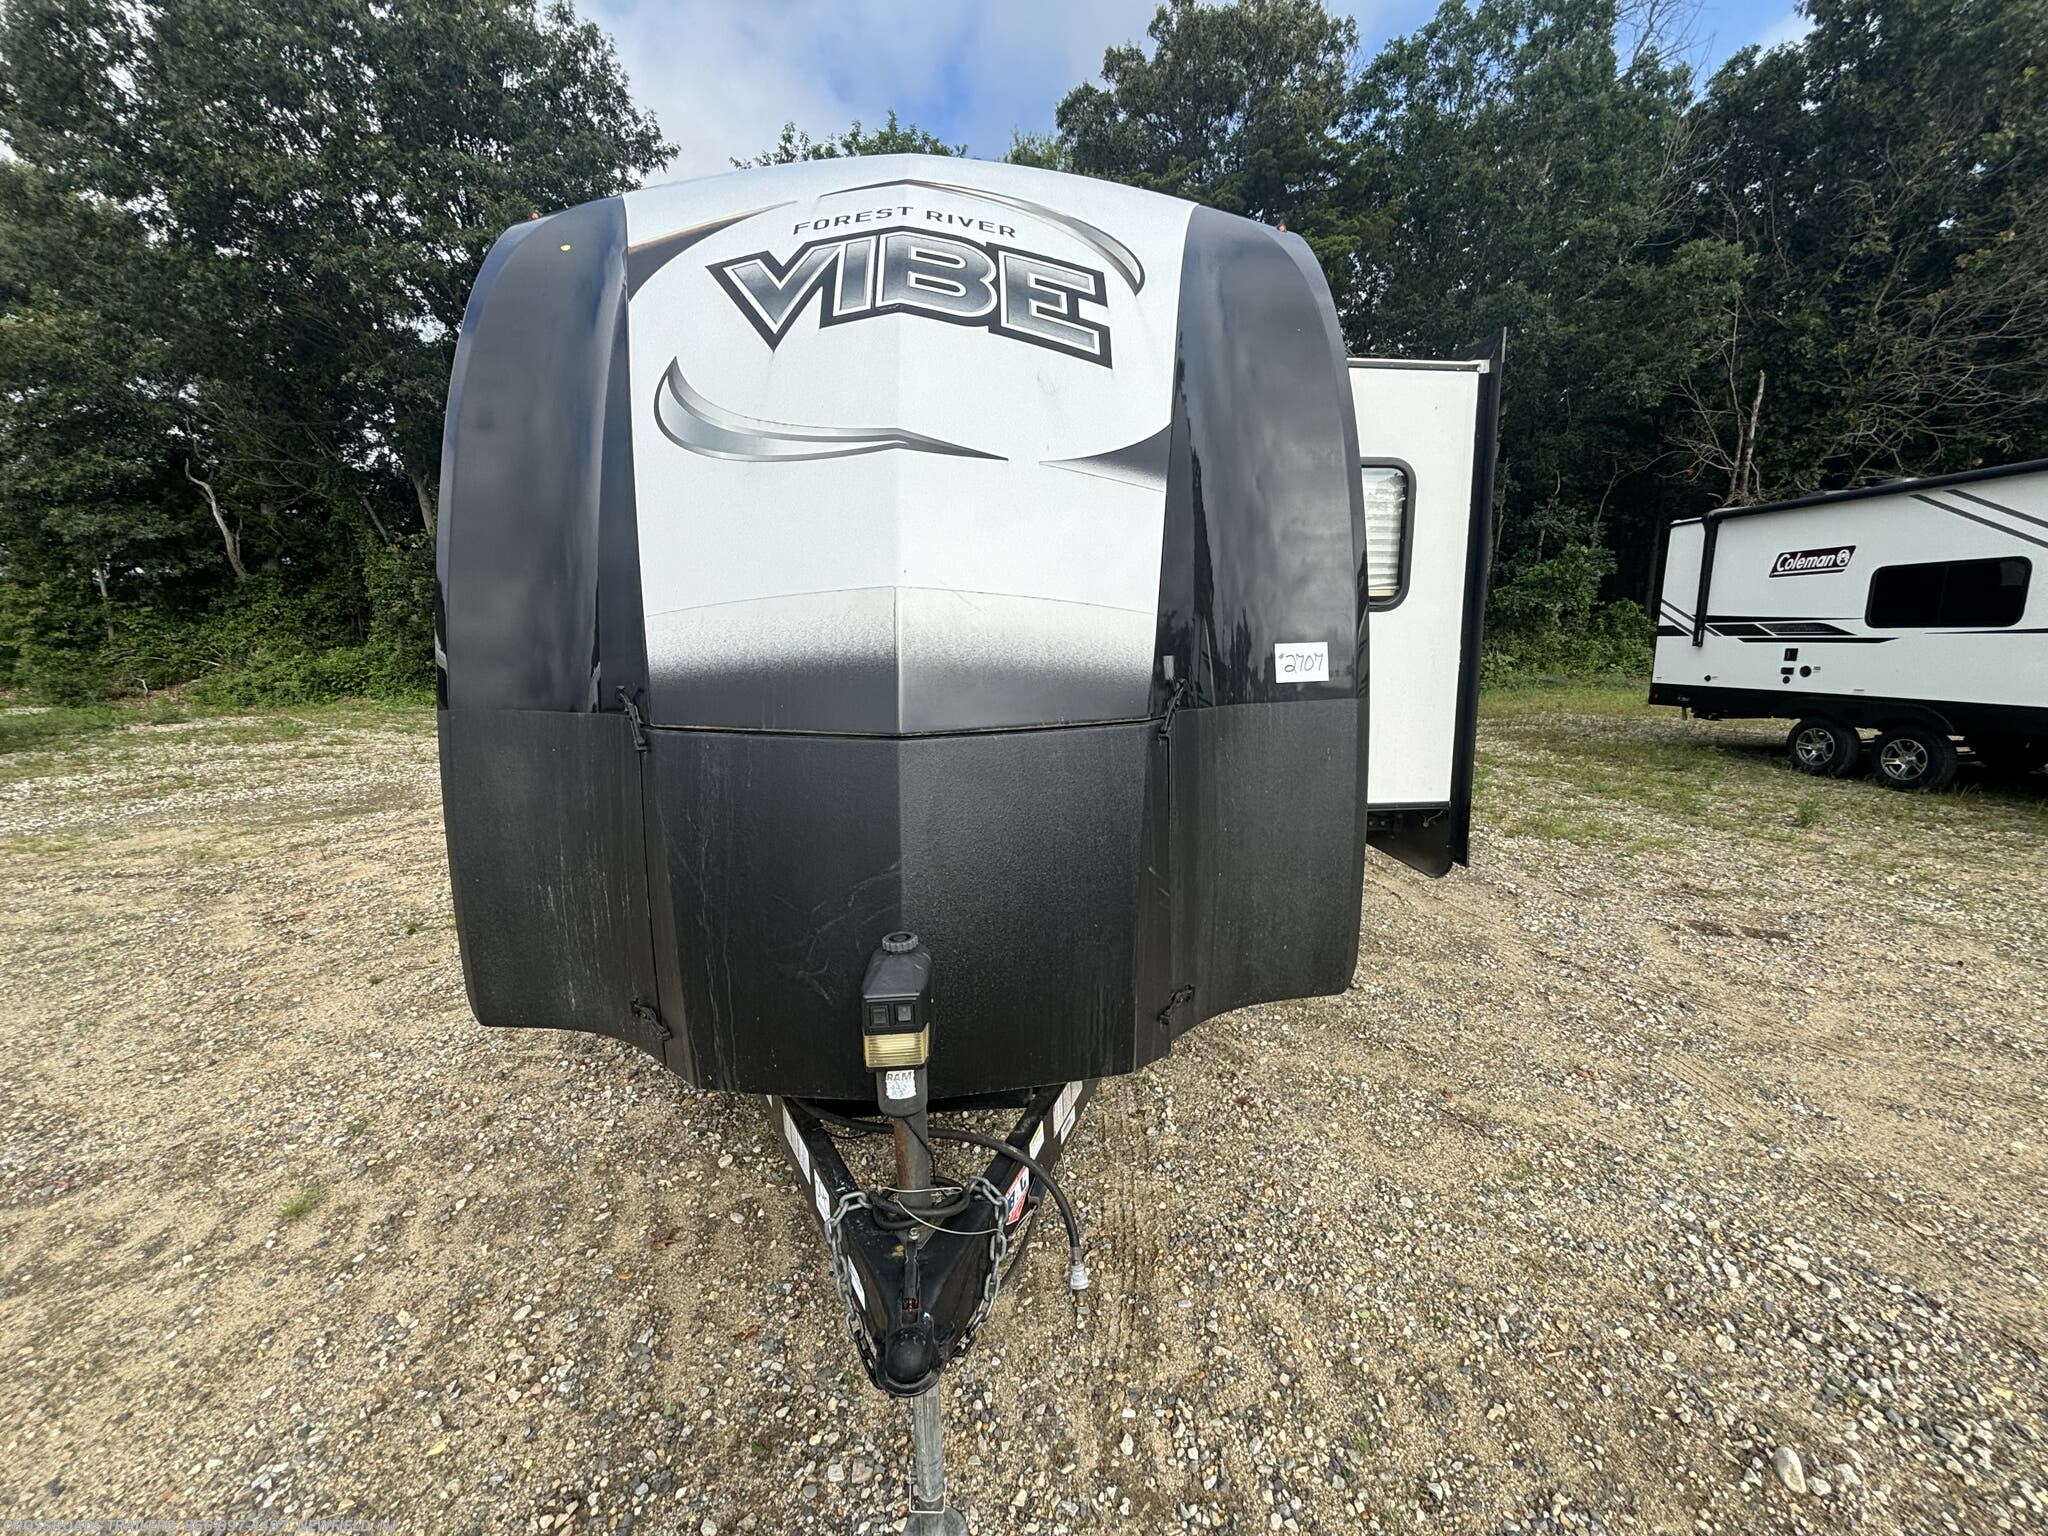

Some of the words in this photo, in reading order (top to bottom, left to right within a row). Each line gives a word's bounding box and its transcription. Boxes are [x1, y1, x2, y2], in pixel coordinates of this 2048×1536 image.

[793, 206, 914, 236] FOREST
[926, 210, 1017, 239] RIVER
[705, 226, 1113, 368] VIBE
[1776, 552, 1836, 572] Coleman
[1278, 652, 1324, 674] #2707
[886, 1071, 913, 1082] RAM
